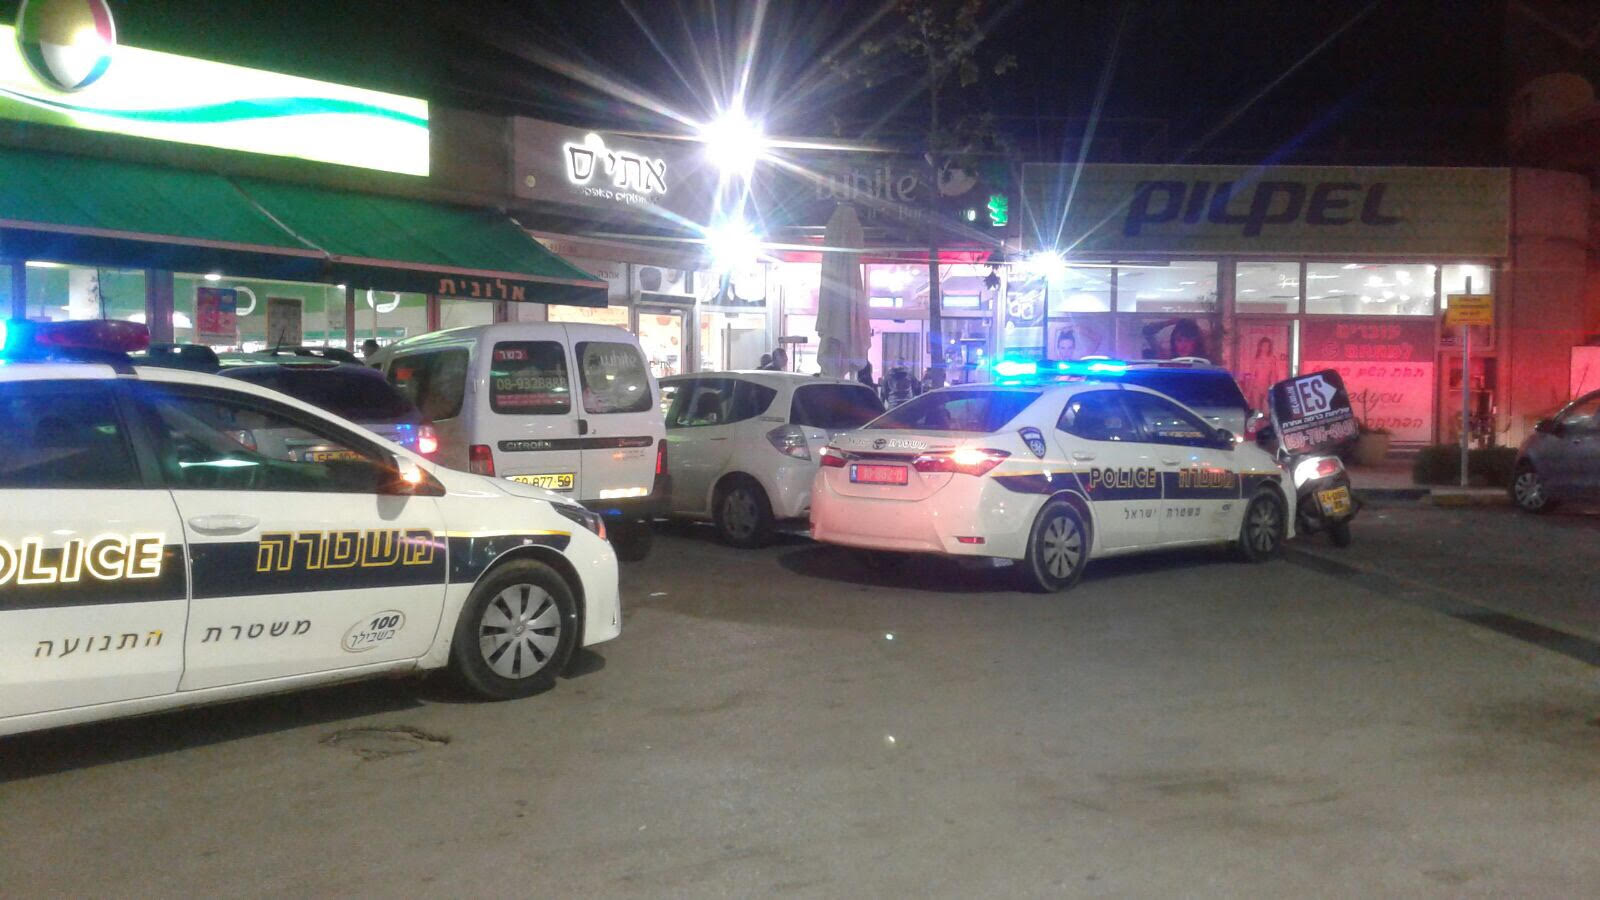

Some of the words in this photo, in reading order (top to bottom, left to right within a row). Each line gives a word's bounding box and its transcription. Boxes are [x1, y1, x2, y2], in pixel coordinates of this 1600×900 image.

[439, 278, 526, 302] אלונית
[501, 350, 524, 360] כשר
[1298, 378, 1328, 413] ES
[1090, 467, 1156, 489] POLICE
[256, 528, 435, 572] משטרה
[201, 618, 312, 644] משטרת
[370, 614, 400, 631] 100
[34, 629, 163, 658] התנועה
[350, 628, 395, 648] בשבילך
